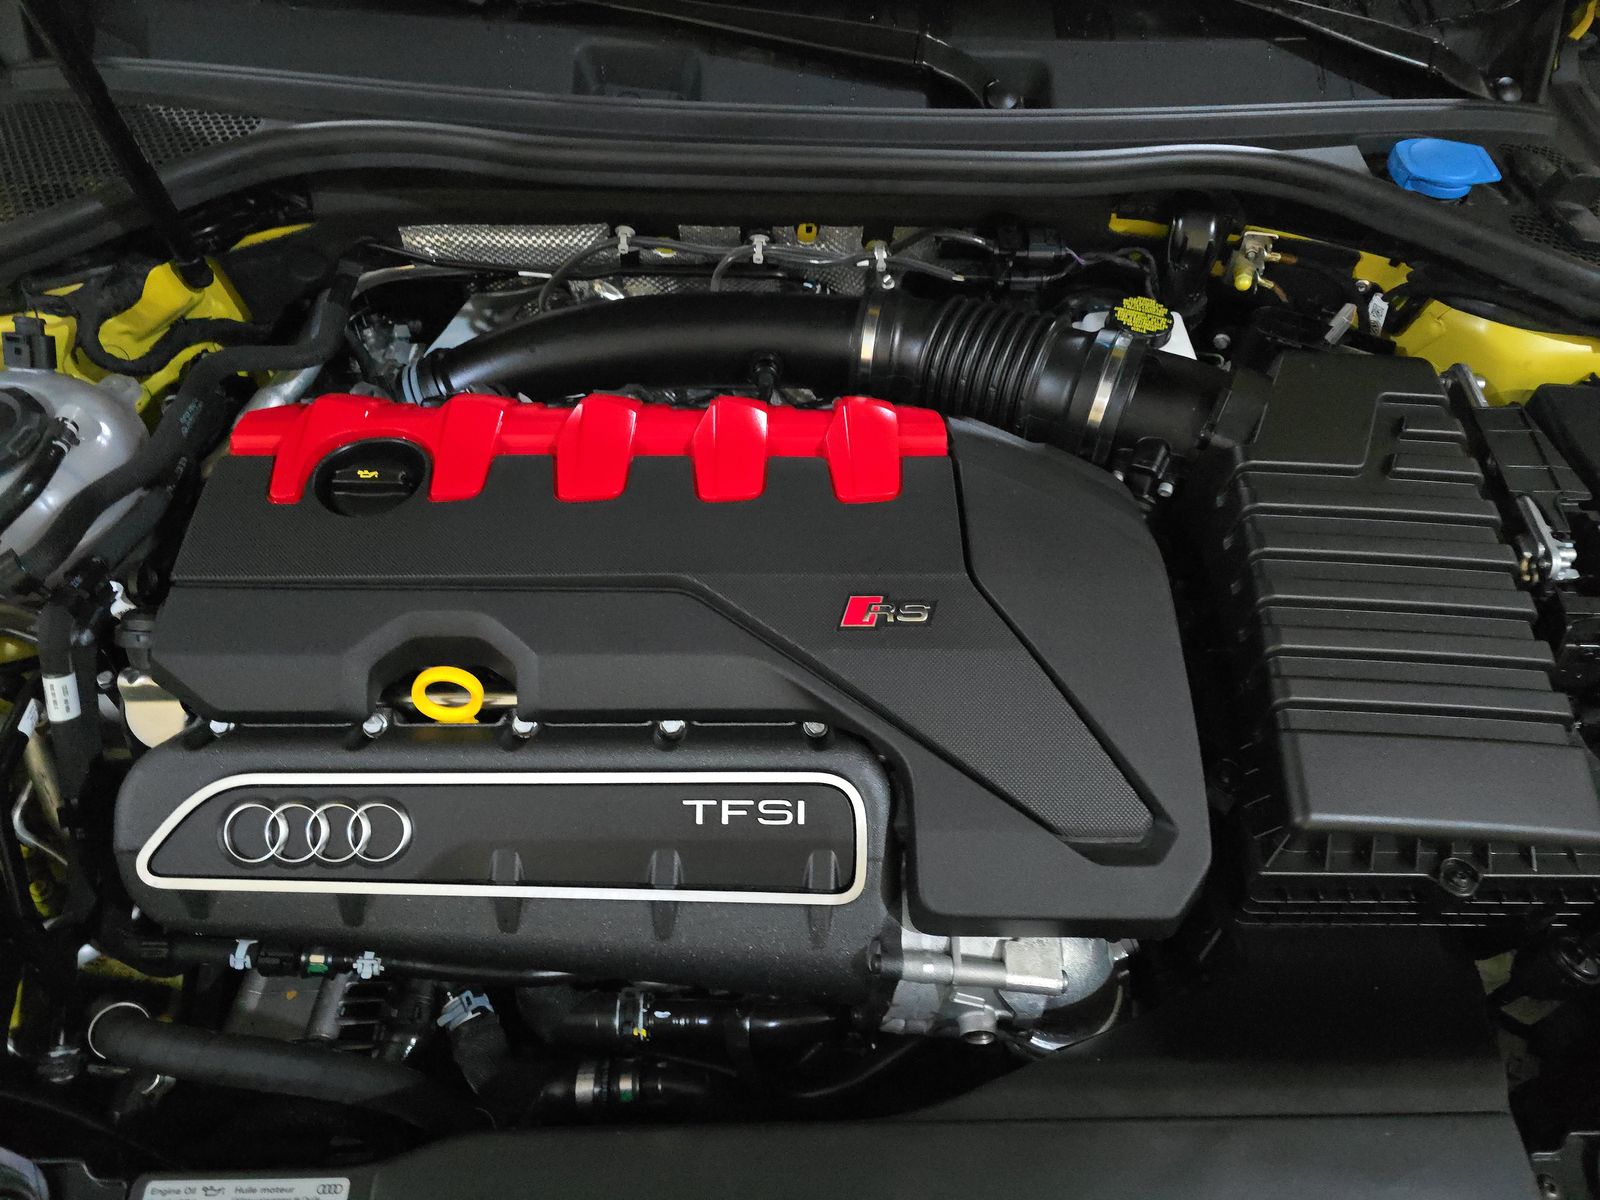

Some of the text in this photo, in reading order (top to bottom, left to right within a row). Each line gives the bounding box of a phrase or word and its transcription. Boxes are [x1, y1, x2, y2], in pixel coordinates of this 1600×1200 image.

[859, 602, 932, 624] RS
[682, 799, 805, 825] TFSI
[150, 1187, 197, 1196] Engine Oil
[234, 1186, 295, 1194] Huile moteur
